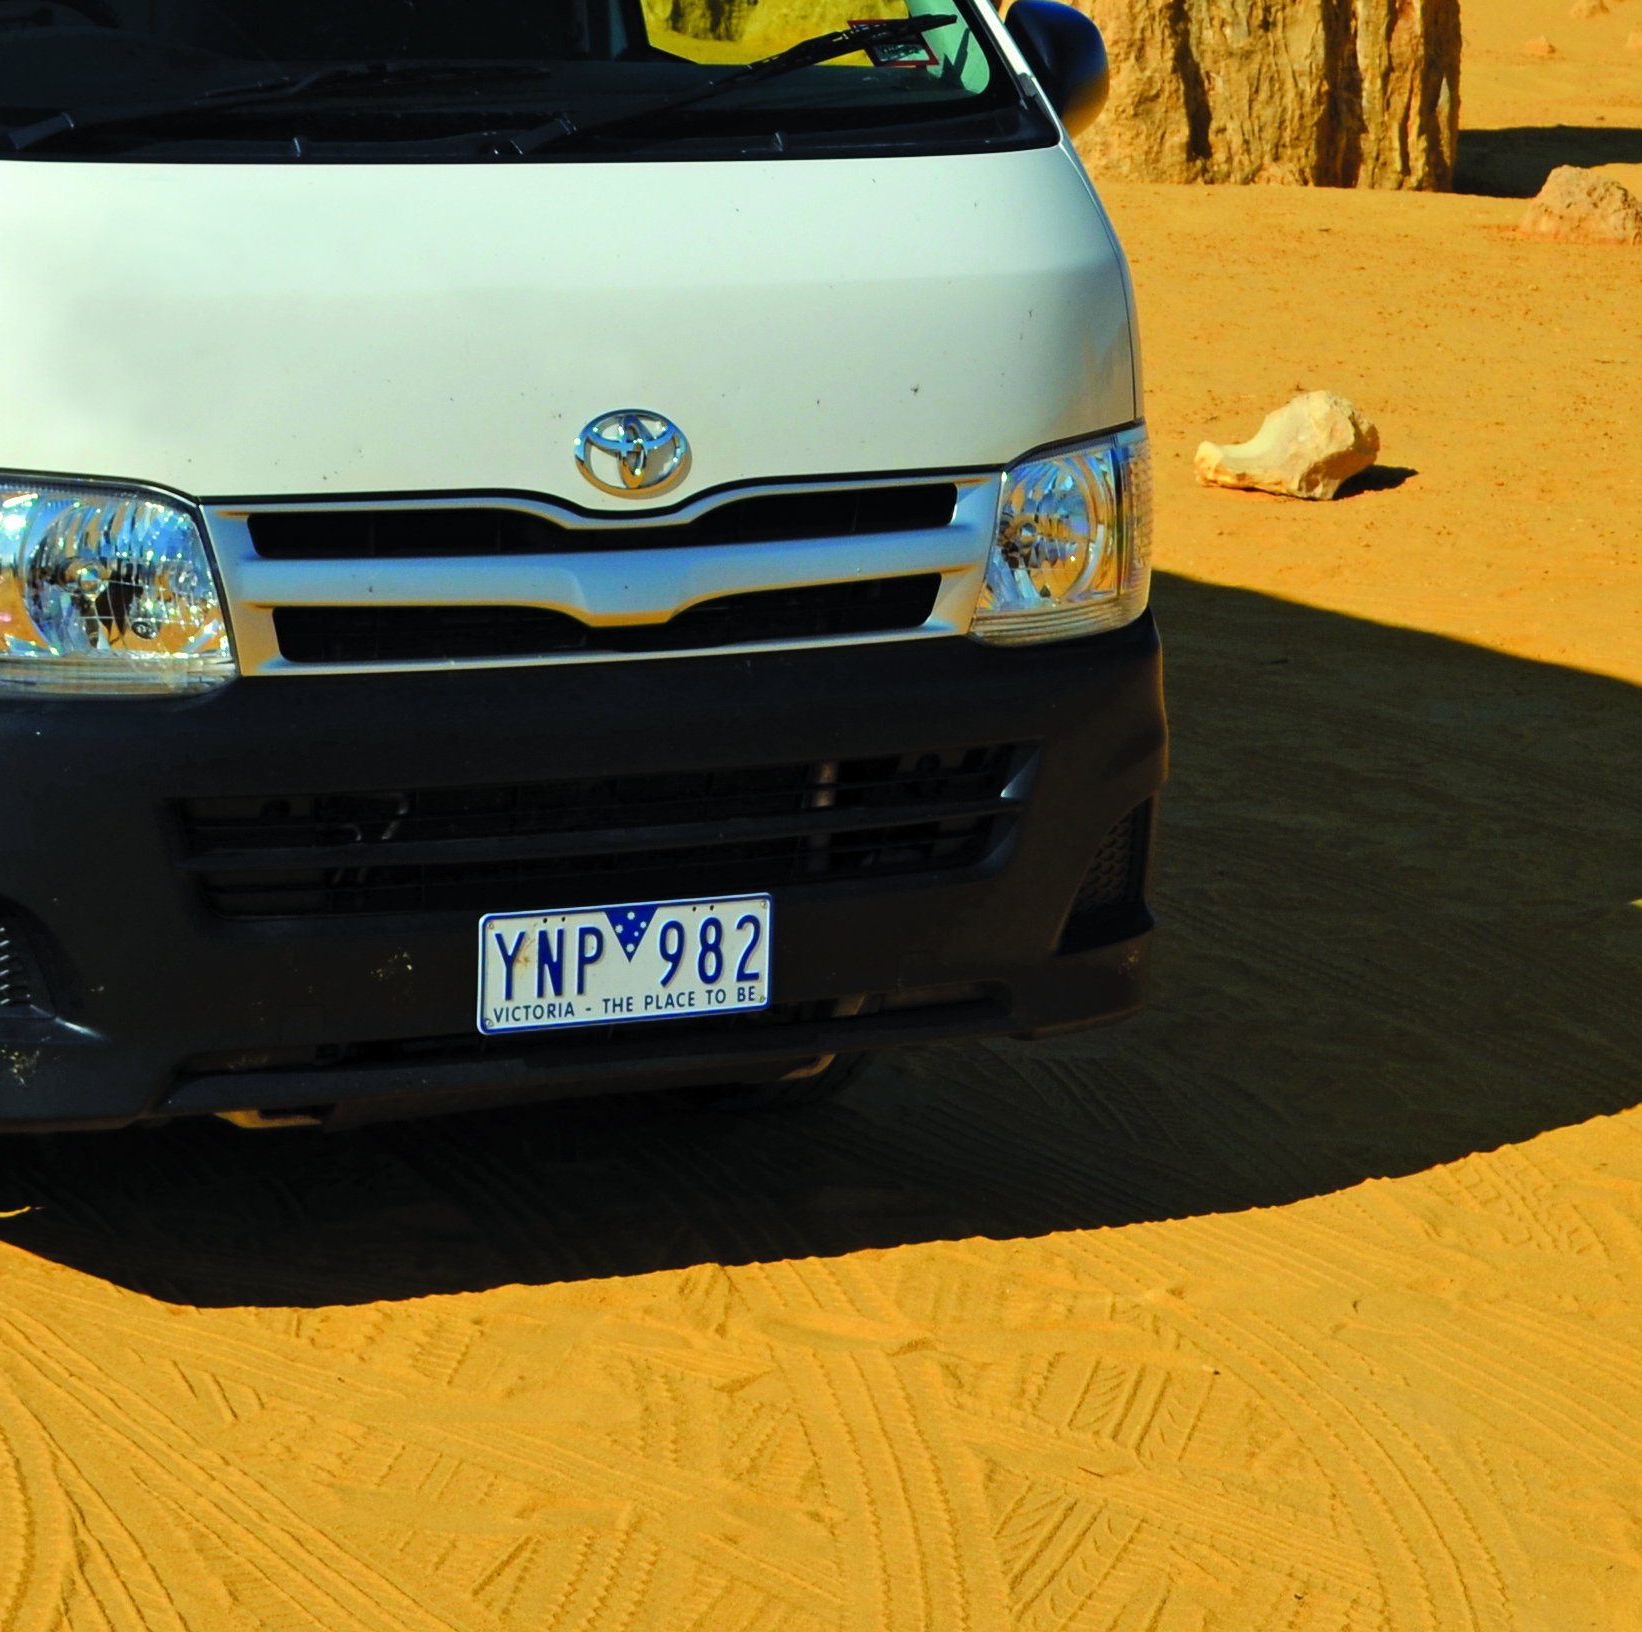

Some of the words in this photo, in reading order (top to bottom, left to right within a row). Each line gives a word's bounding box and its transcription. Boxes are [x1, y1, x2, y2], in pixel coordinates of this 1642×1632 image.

[494, 926, 604, 1001] YNP
[658, 914, 761, 988] 982
[493, 1001, 575, 1024] VICTORIA
[602, 996, 633, 1015] THE
[644, 991, 696, 1010] PLACE
[706, 987, 727, 1006] TO
[737, 985, 756, 1003] BE
